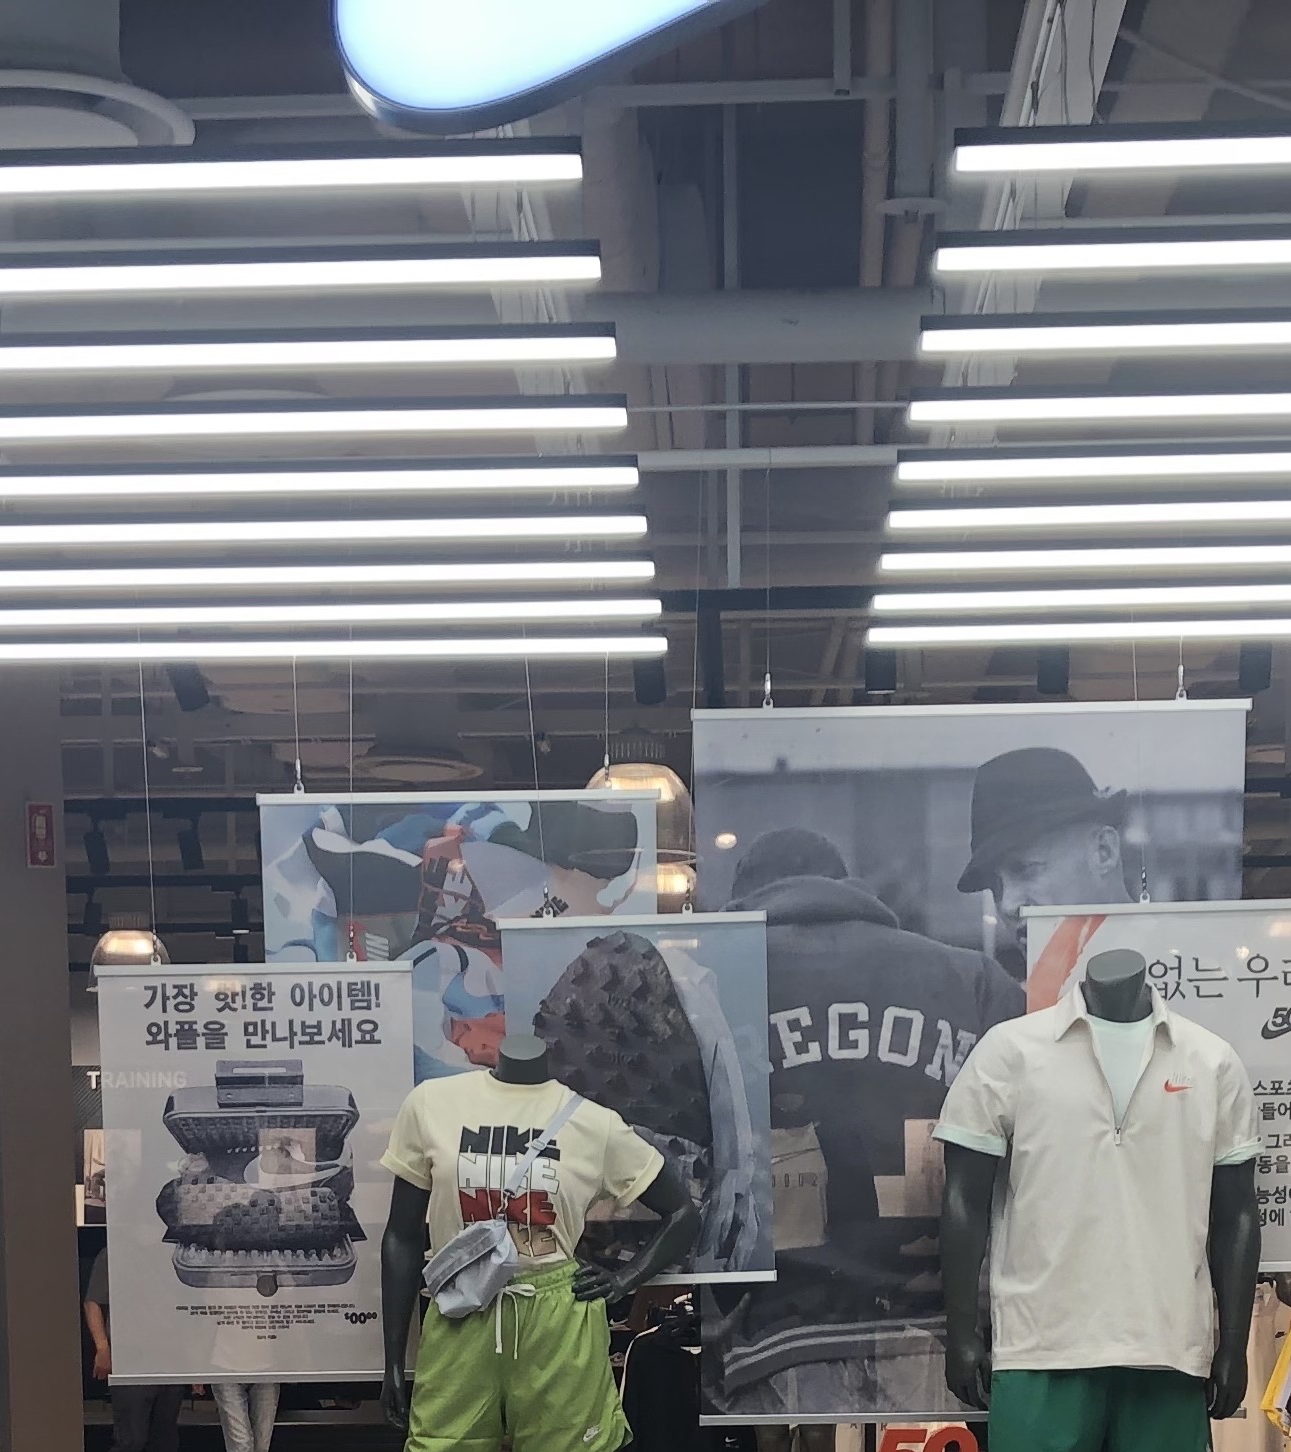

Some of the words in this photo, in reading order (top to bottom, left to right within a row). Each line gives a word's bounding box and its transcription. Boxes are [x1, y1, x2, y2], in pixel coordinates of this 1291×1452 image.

[143, 982, 199, 1013] 가장
[290, 980, 381, 1012] 아이템!
[145, 1019, 229, 1051] 와플을
[243, 1018, 382, 1049] 만나보세요
[770, 1001, 977, 1087] EGON
[86, 1071, 187, 1090] TRAINING
[459, 1125, 561, 1161] NIKE
